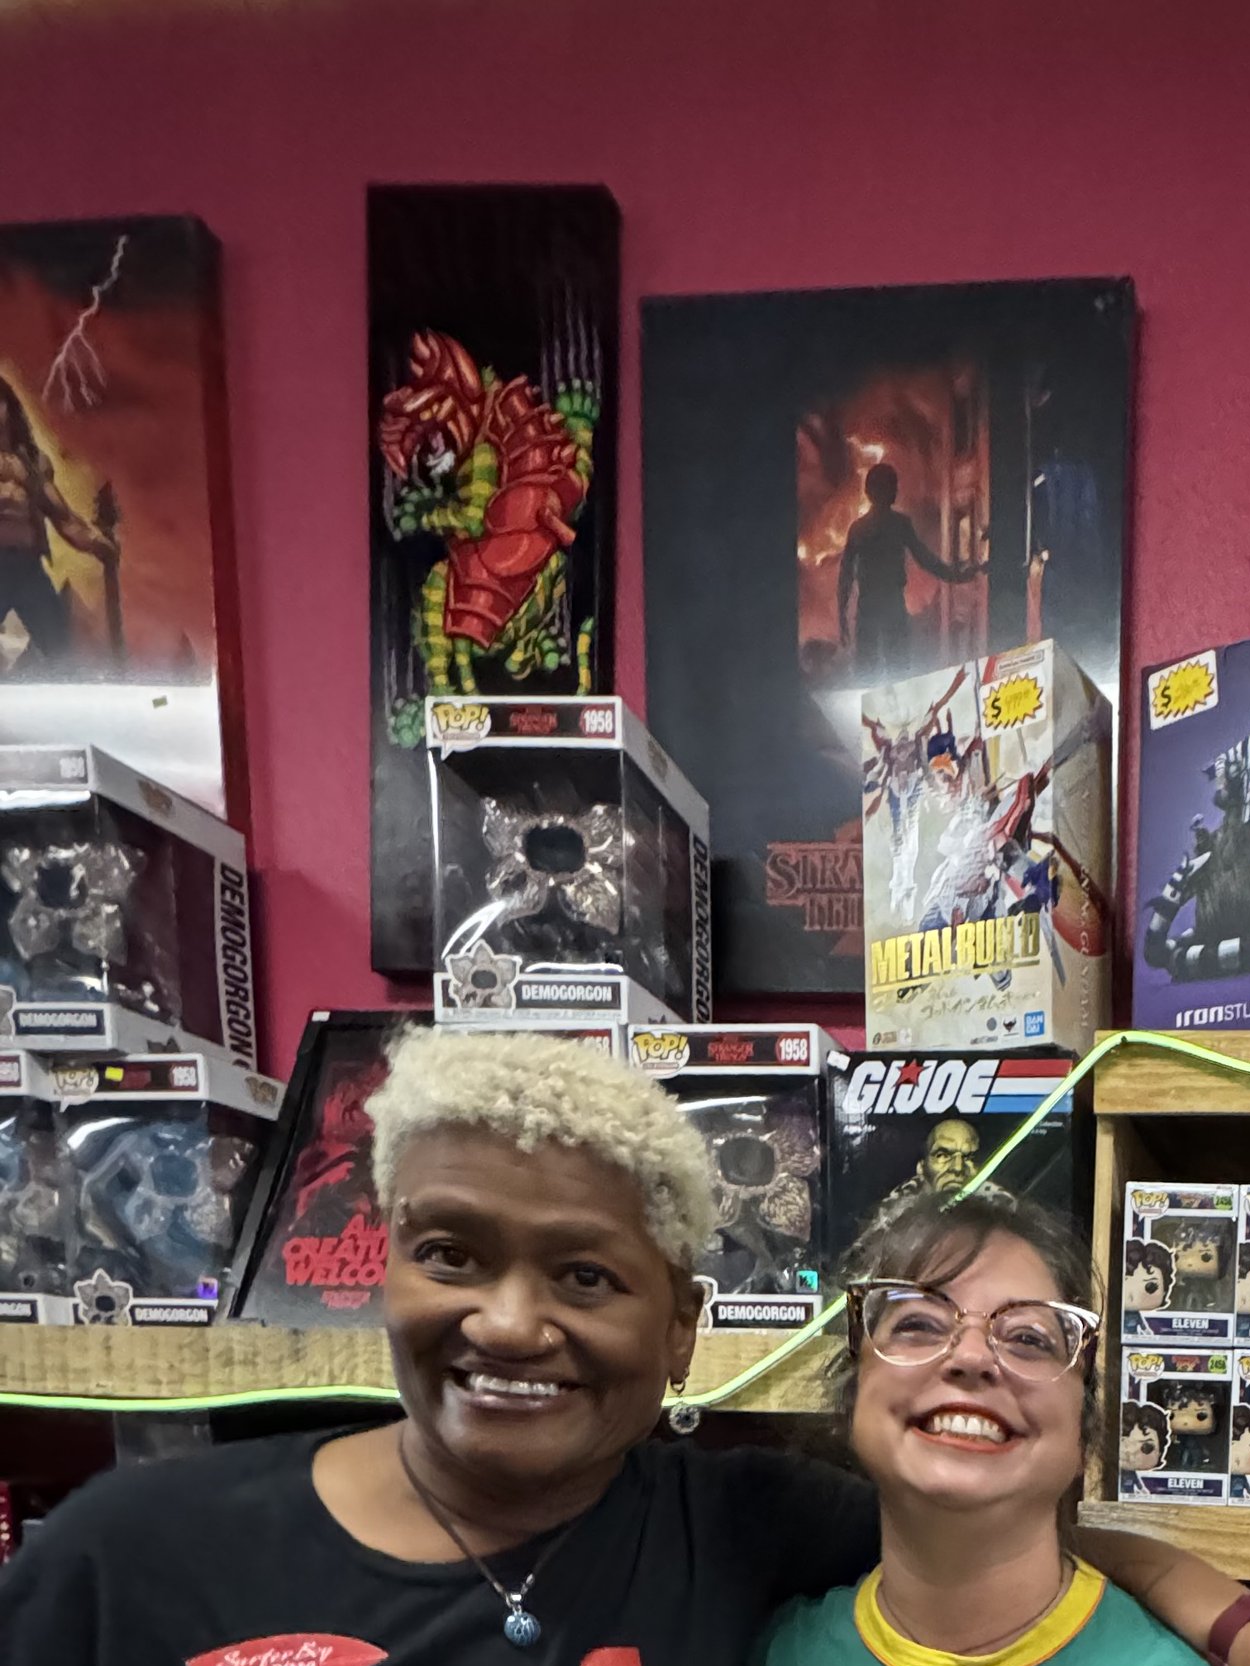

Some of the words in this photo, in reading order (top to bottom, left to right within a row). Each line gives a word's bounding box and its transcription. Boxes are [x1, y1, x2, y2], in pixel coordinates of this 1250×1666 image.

[432, 703, 490, 732] POP!
[583, 710, 614, 734] 1958
[220, 863, 256, 1057] DEMOGORGON
[521, 983, 612, 1002] DEMOGORGON
[633, 1034, 688, 1060] POP!
[777, 1038, 808, 1060] 1958
[285, 1257, 388, 1286] WELCO
[717, 1304, 806, 1322] DEMOGORGON
[1171, 1318, 1209, 1330] ELEVEN
[1167, 1477, 1204, 1490] ELEVEN
